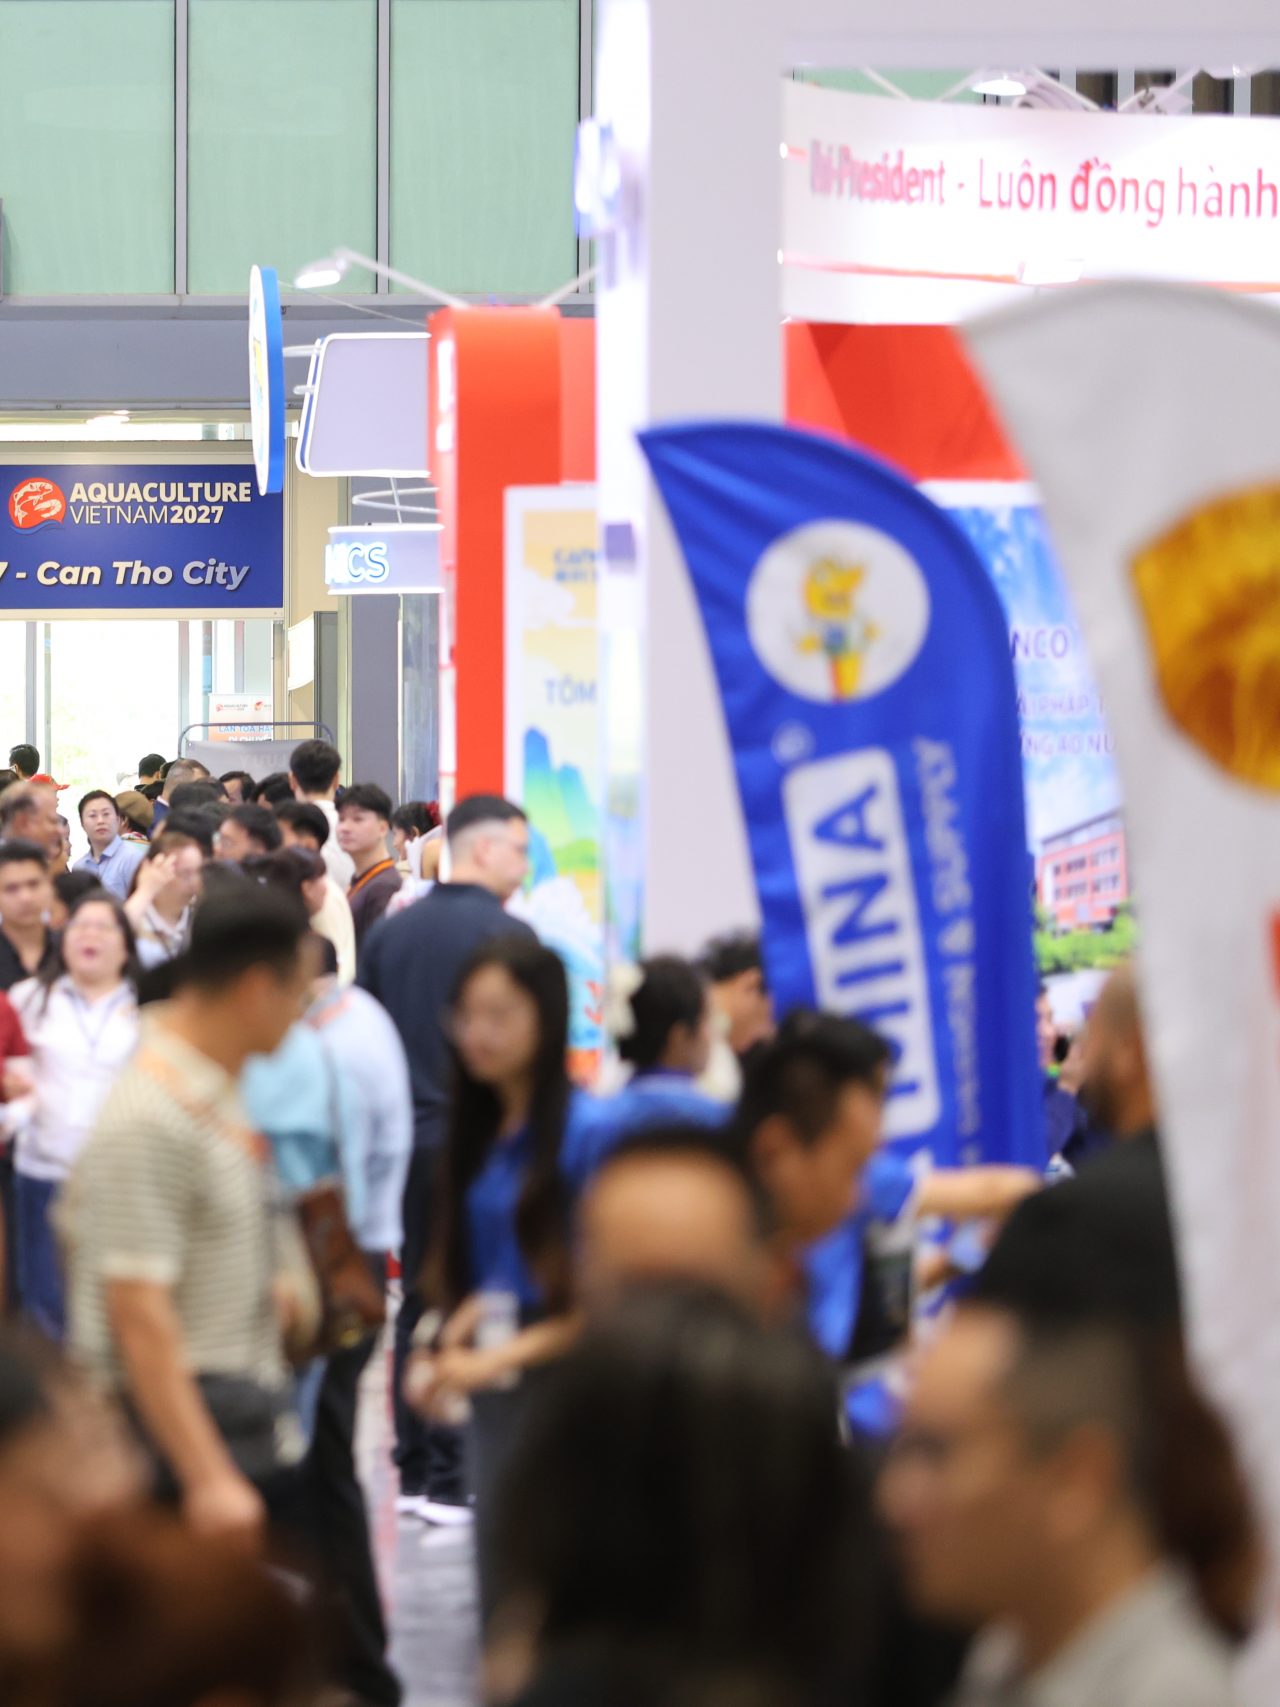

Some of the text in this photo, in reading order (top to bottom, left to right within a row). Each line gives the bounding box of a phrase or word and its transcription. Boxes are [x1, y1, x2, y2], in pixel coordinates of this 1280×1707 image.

[978, 157, 1057, 211] Luôn
[1070, 156, 1166, 229] đồng
[1177, 164, 1278, 219] hành
[69, 482, 252, 504] AQUACULTURE
[36, 560, 102, 586] Can
[112, 559, 173, 586] Tho
[182, 557, 251, 591] City
